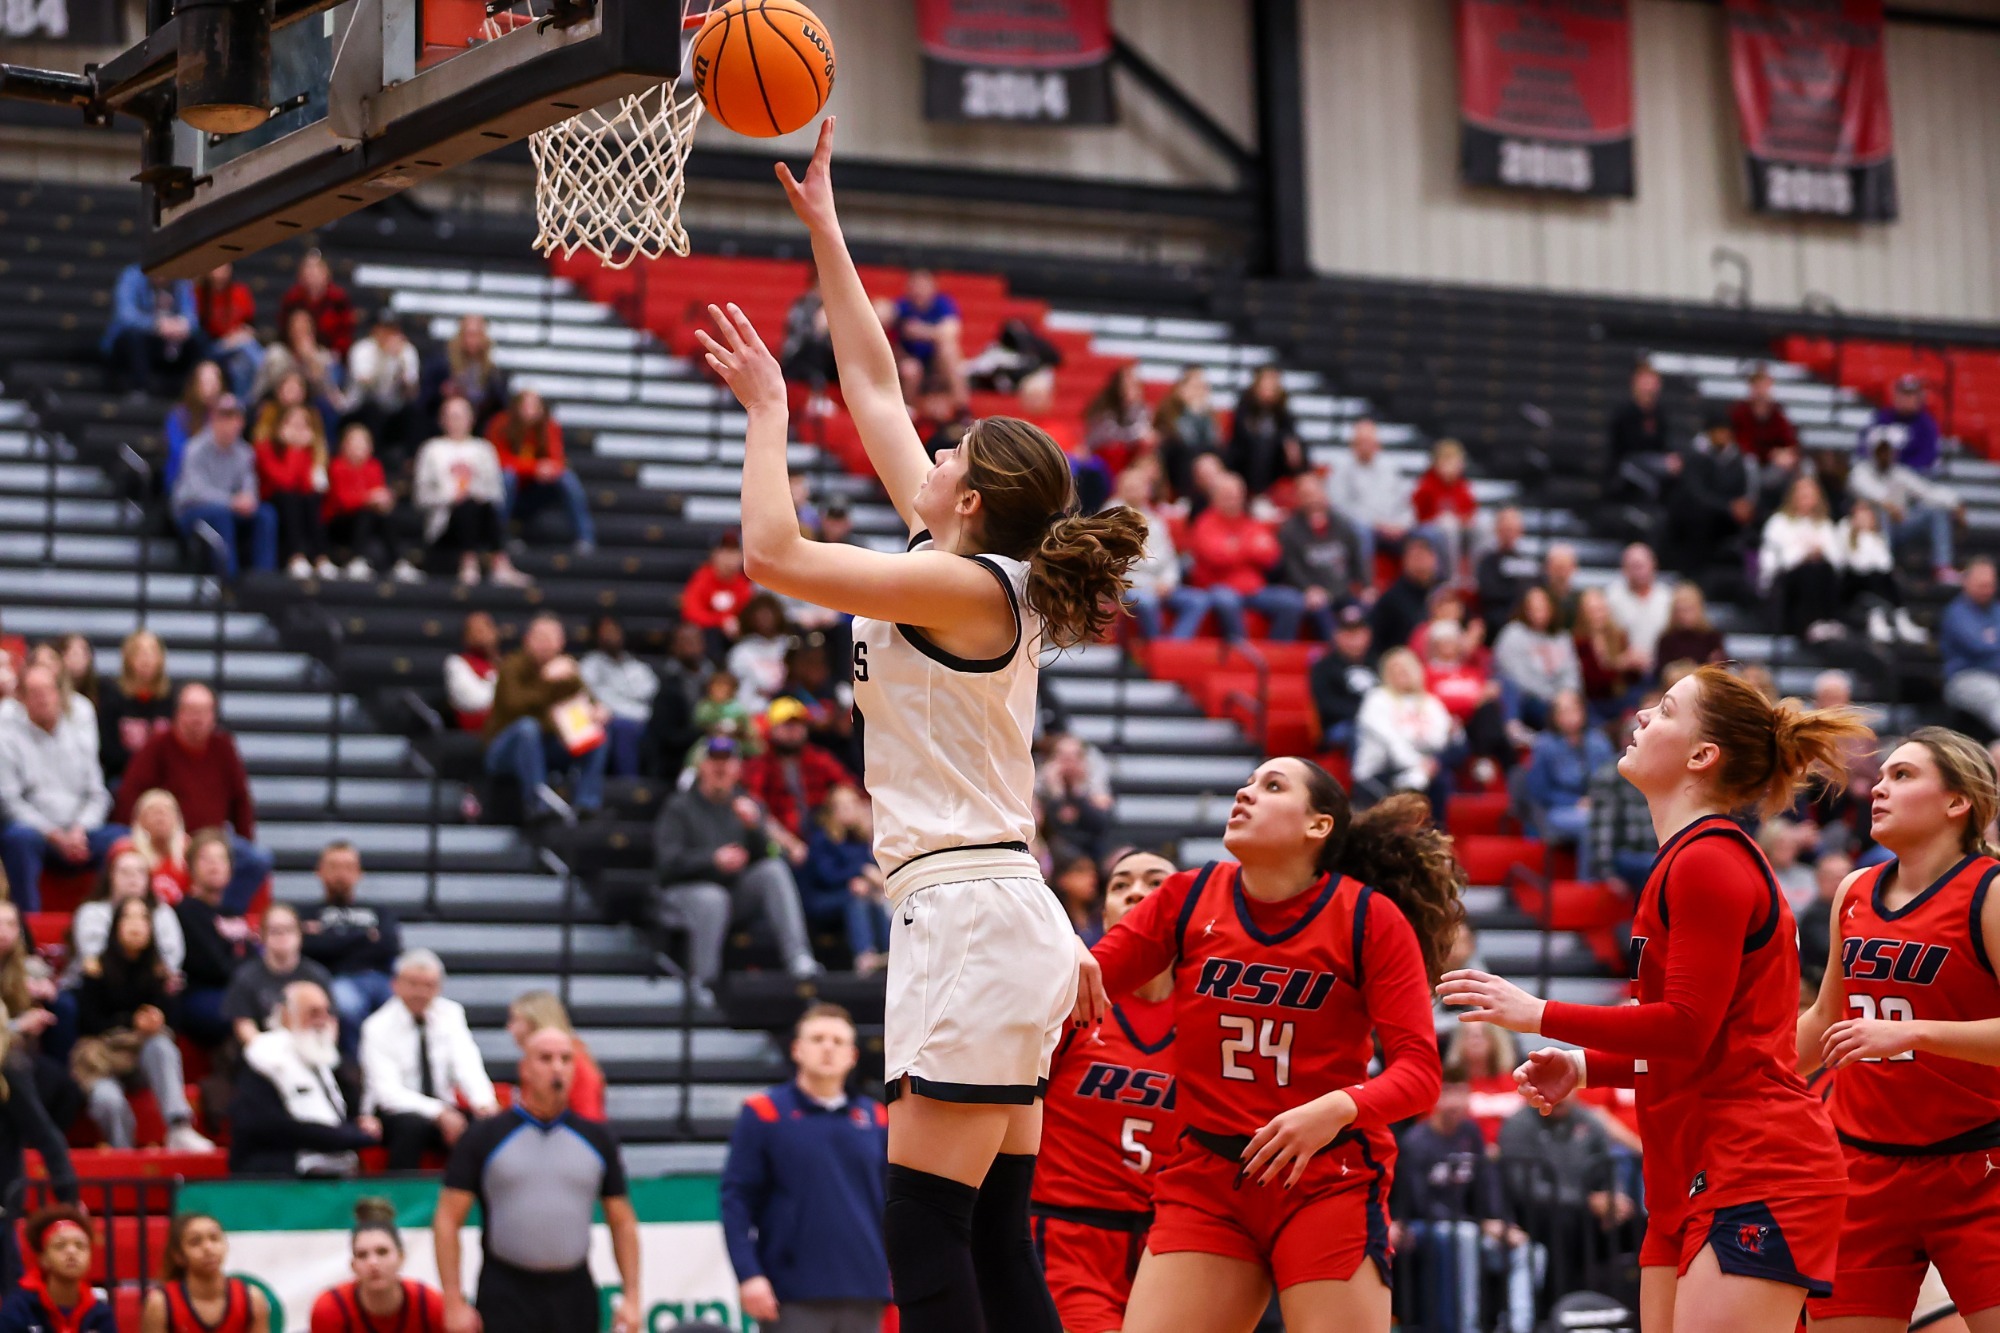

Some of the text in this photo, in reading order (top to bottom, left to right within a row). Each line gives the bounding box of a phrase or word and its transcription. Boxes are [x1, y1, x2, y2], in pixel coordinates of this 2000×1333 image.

[853, 641, 869, 682] S
[1196, 957, 1337, 1010] RSU
[1219, 1014, 1295, 1088] 24
[1121, 1117, 1154, 1175] 5
